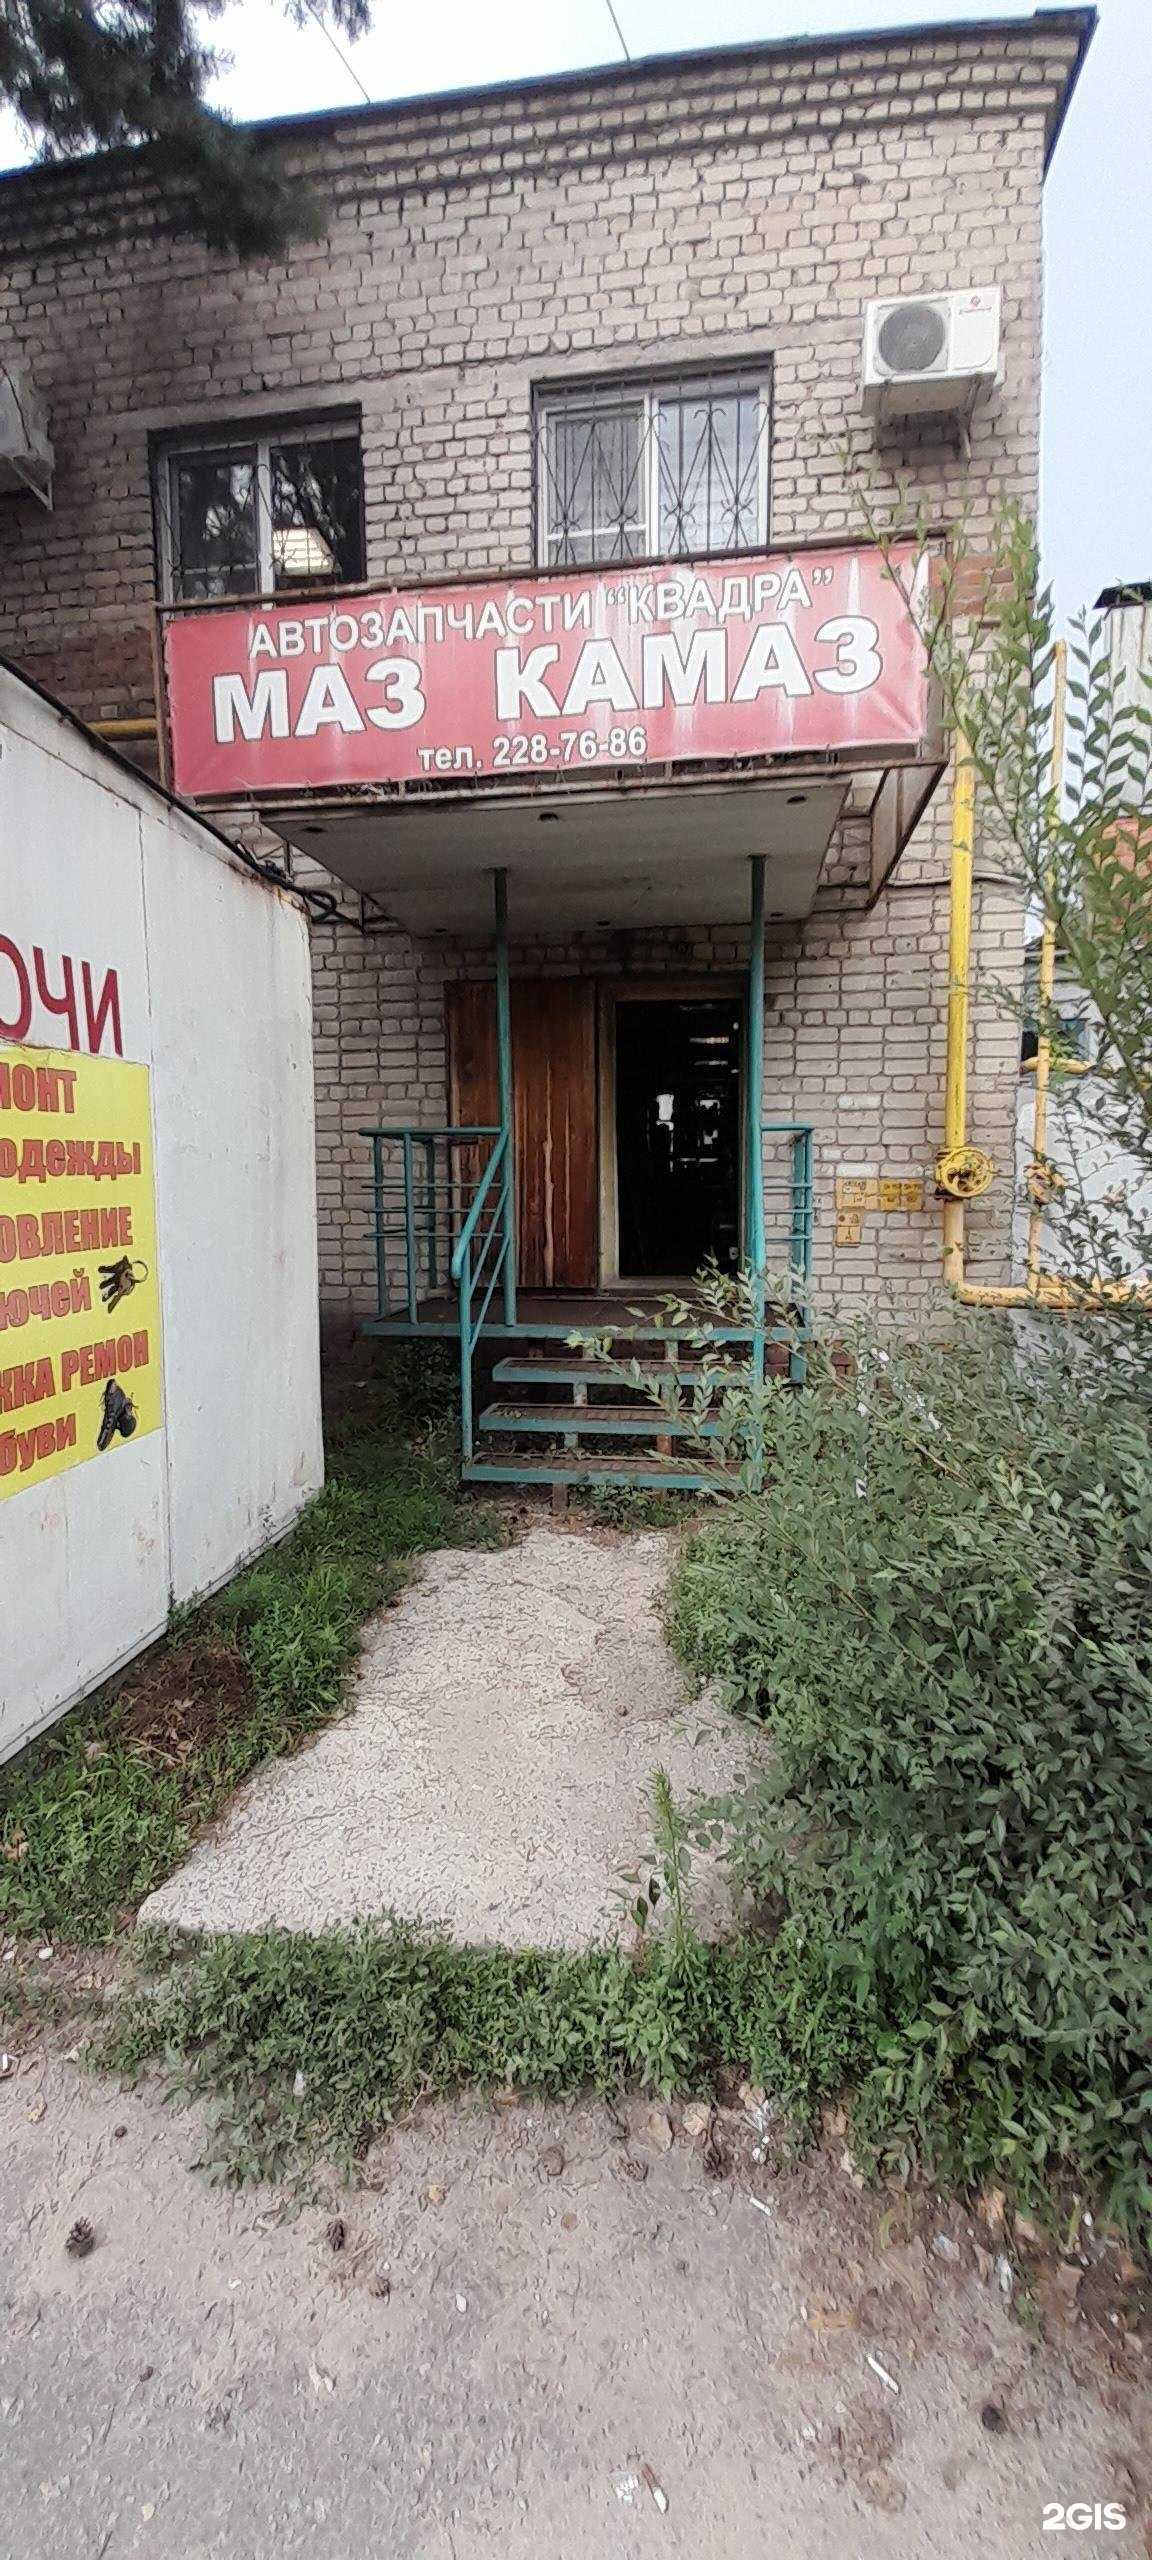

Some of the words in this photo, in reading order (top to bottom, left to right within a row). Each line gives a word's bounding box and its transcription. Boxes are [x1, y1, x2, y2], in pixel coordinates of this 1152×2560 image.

[249, 588, 593, 659] АВТОЗАПЧАСТИ
[212, 655, 427, 744] МАЗ
[495, 614, 884, 722] КАМАЗ
[417, 745, 483, 773] тел.
[492, 725, 648, 766] 228-76-86
[61, 1329, 149, 1392] РЕМОН
